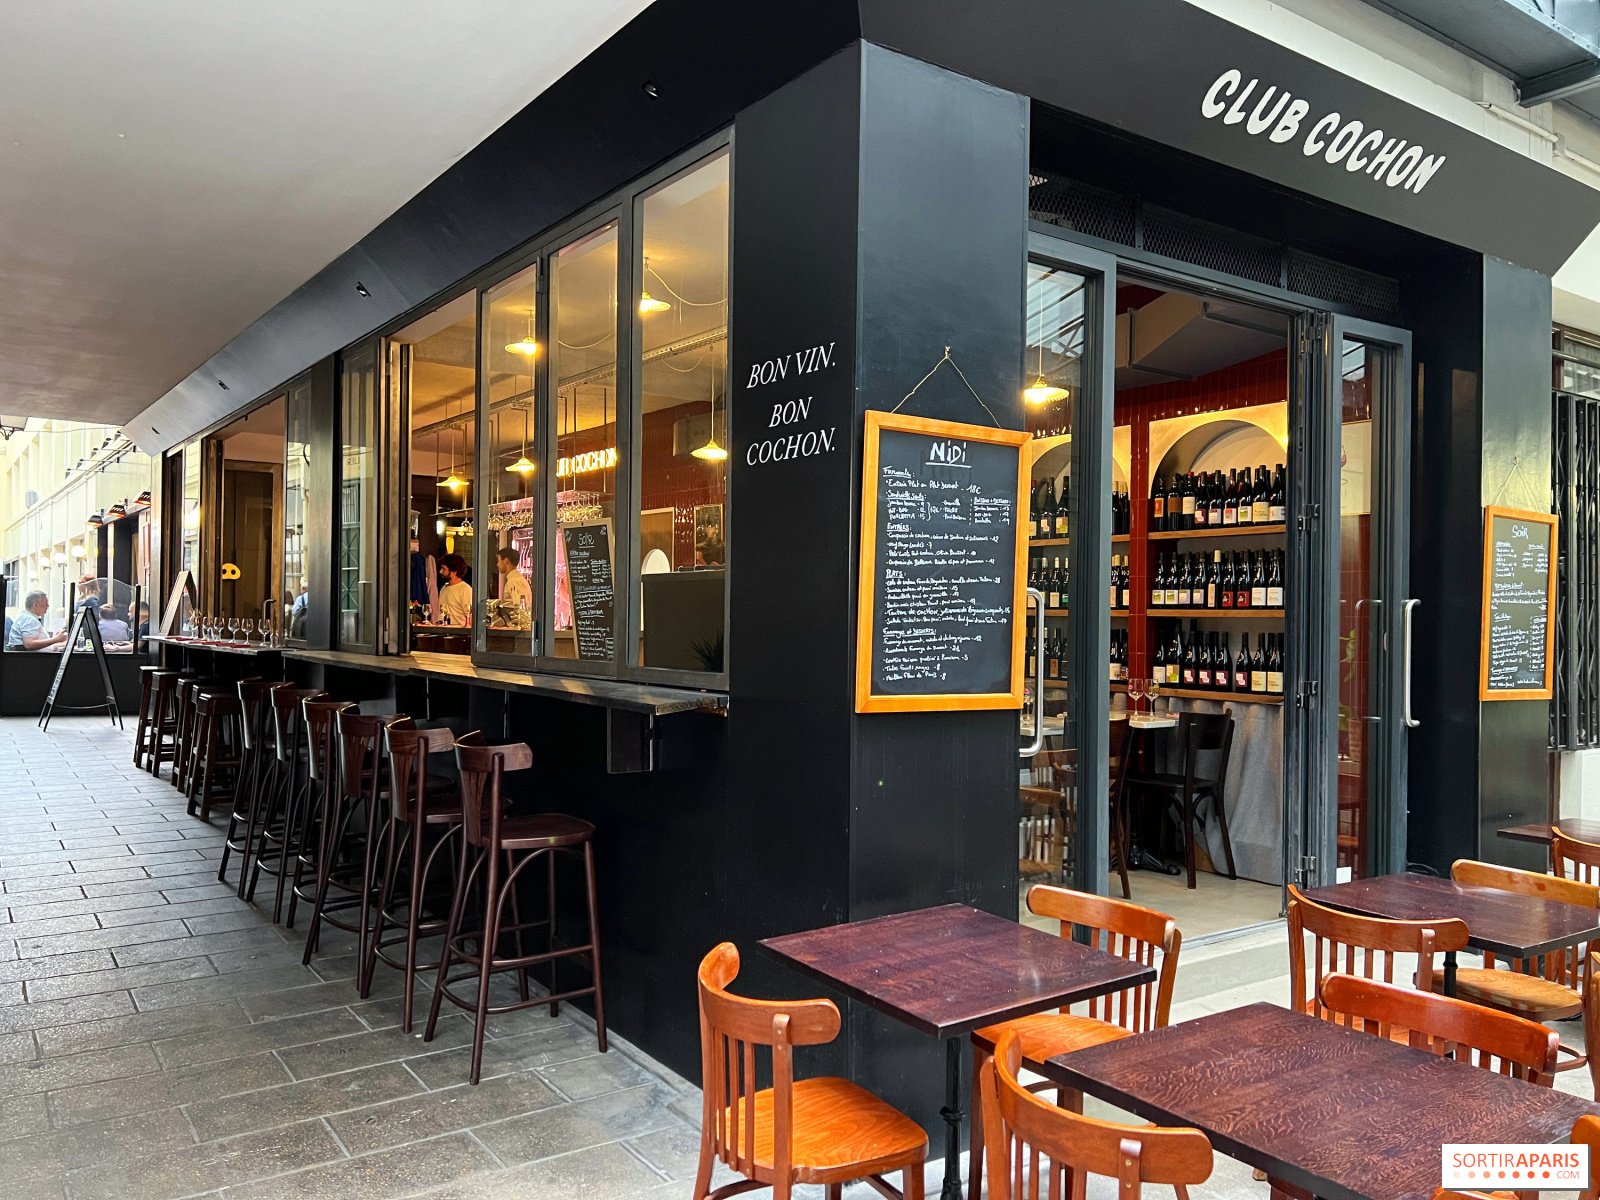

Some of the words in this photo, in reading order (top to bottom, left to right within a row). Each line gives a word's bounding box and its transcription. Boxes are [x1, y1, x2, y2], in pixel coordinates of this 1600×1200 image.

[1201, 69, 1310, 143] CLUB
[1303, 112, 1446, 194] COCHON
[746, 355, 791, 389] BON
[795, 342, 836, 375] VIN.
[768, 396, 813, 428] BON
[746, 427, 836, 466] COCHON.
